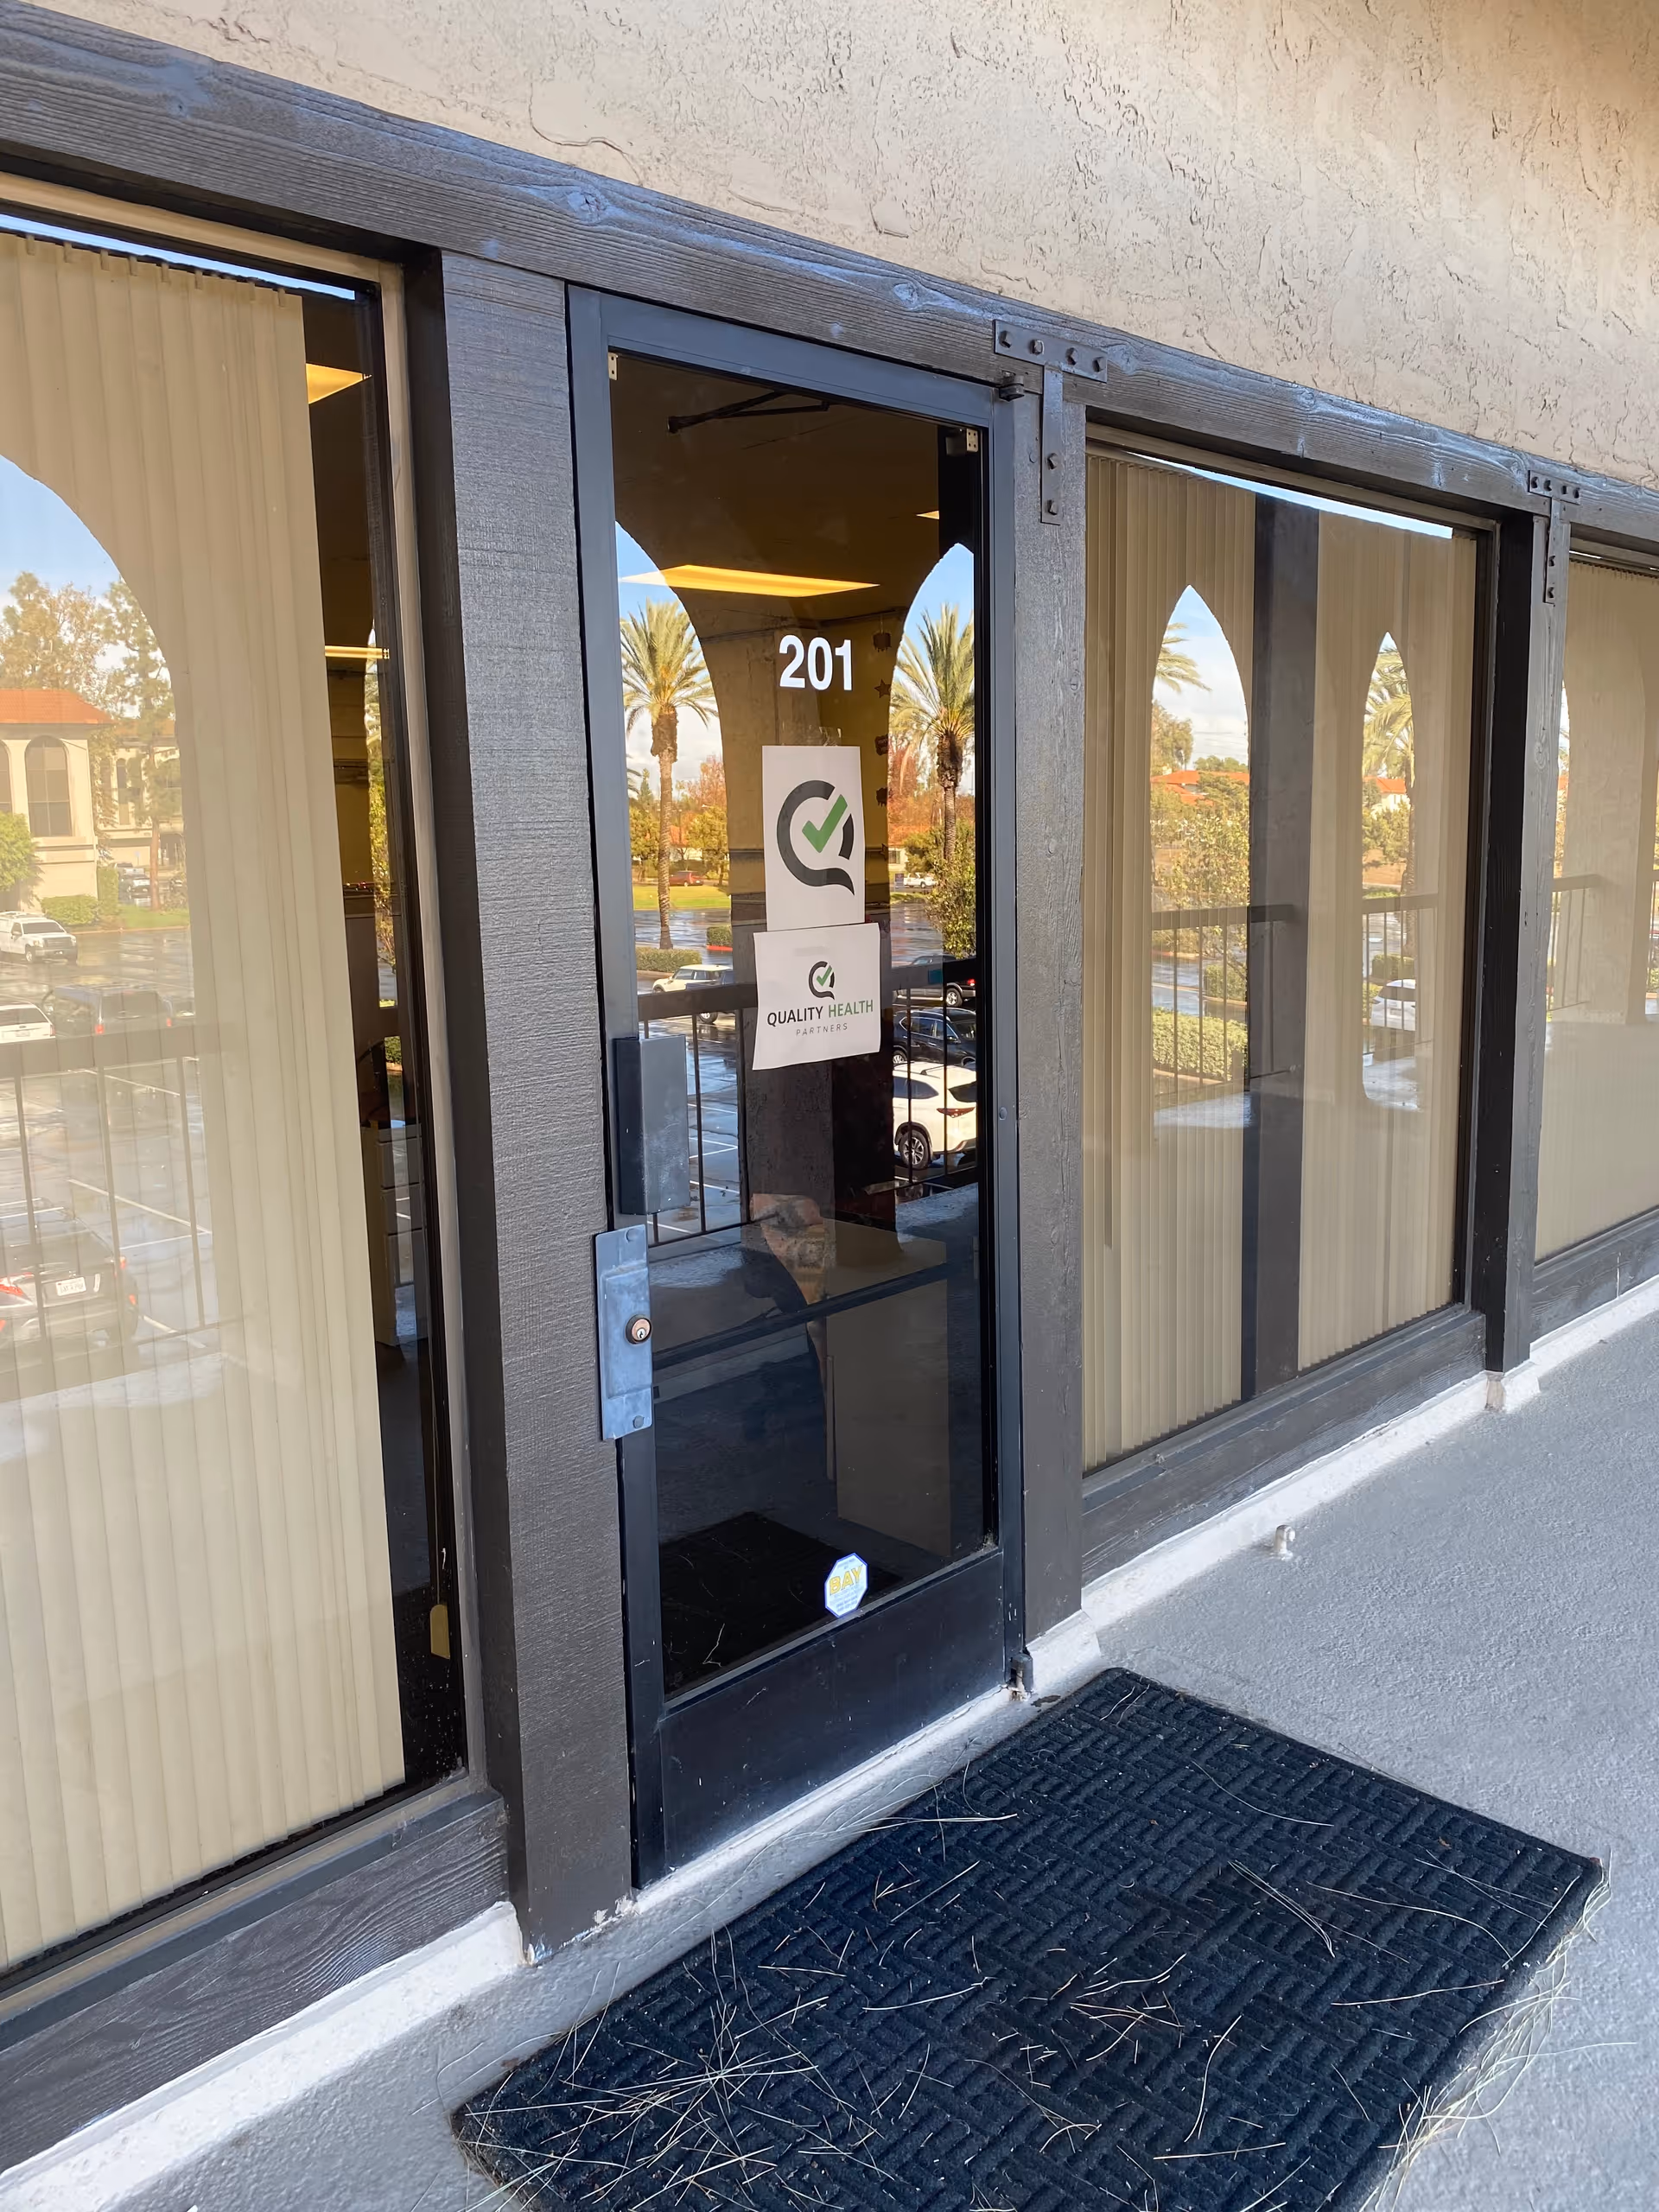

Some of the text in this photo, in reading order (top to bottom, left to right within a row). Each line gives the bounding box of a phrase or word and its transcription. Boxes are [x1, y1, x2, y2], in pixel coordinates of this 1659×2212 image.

[779, 634, 852, 690] 201
[766, 1000, 874, 1027] QUALITY HEALTH
[796, 1023, 848, 1036] PARTNERS
[830, 1565, 863, 1596] BAY
